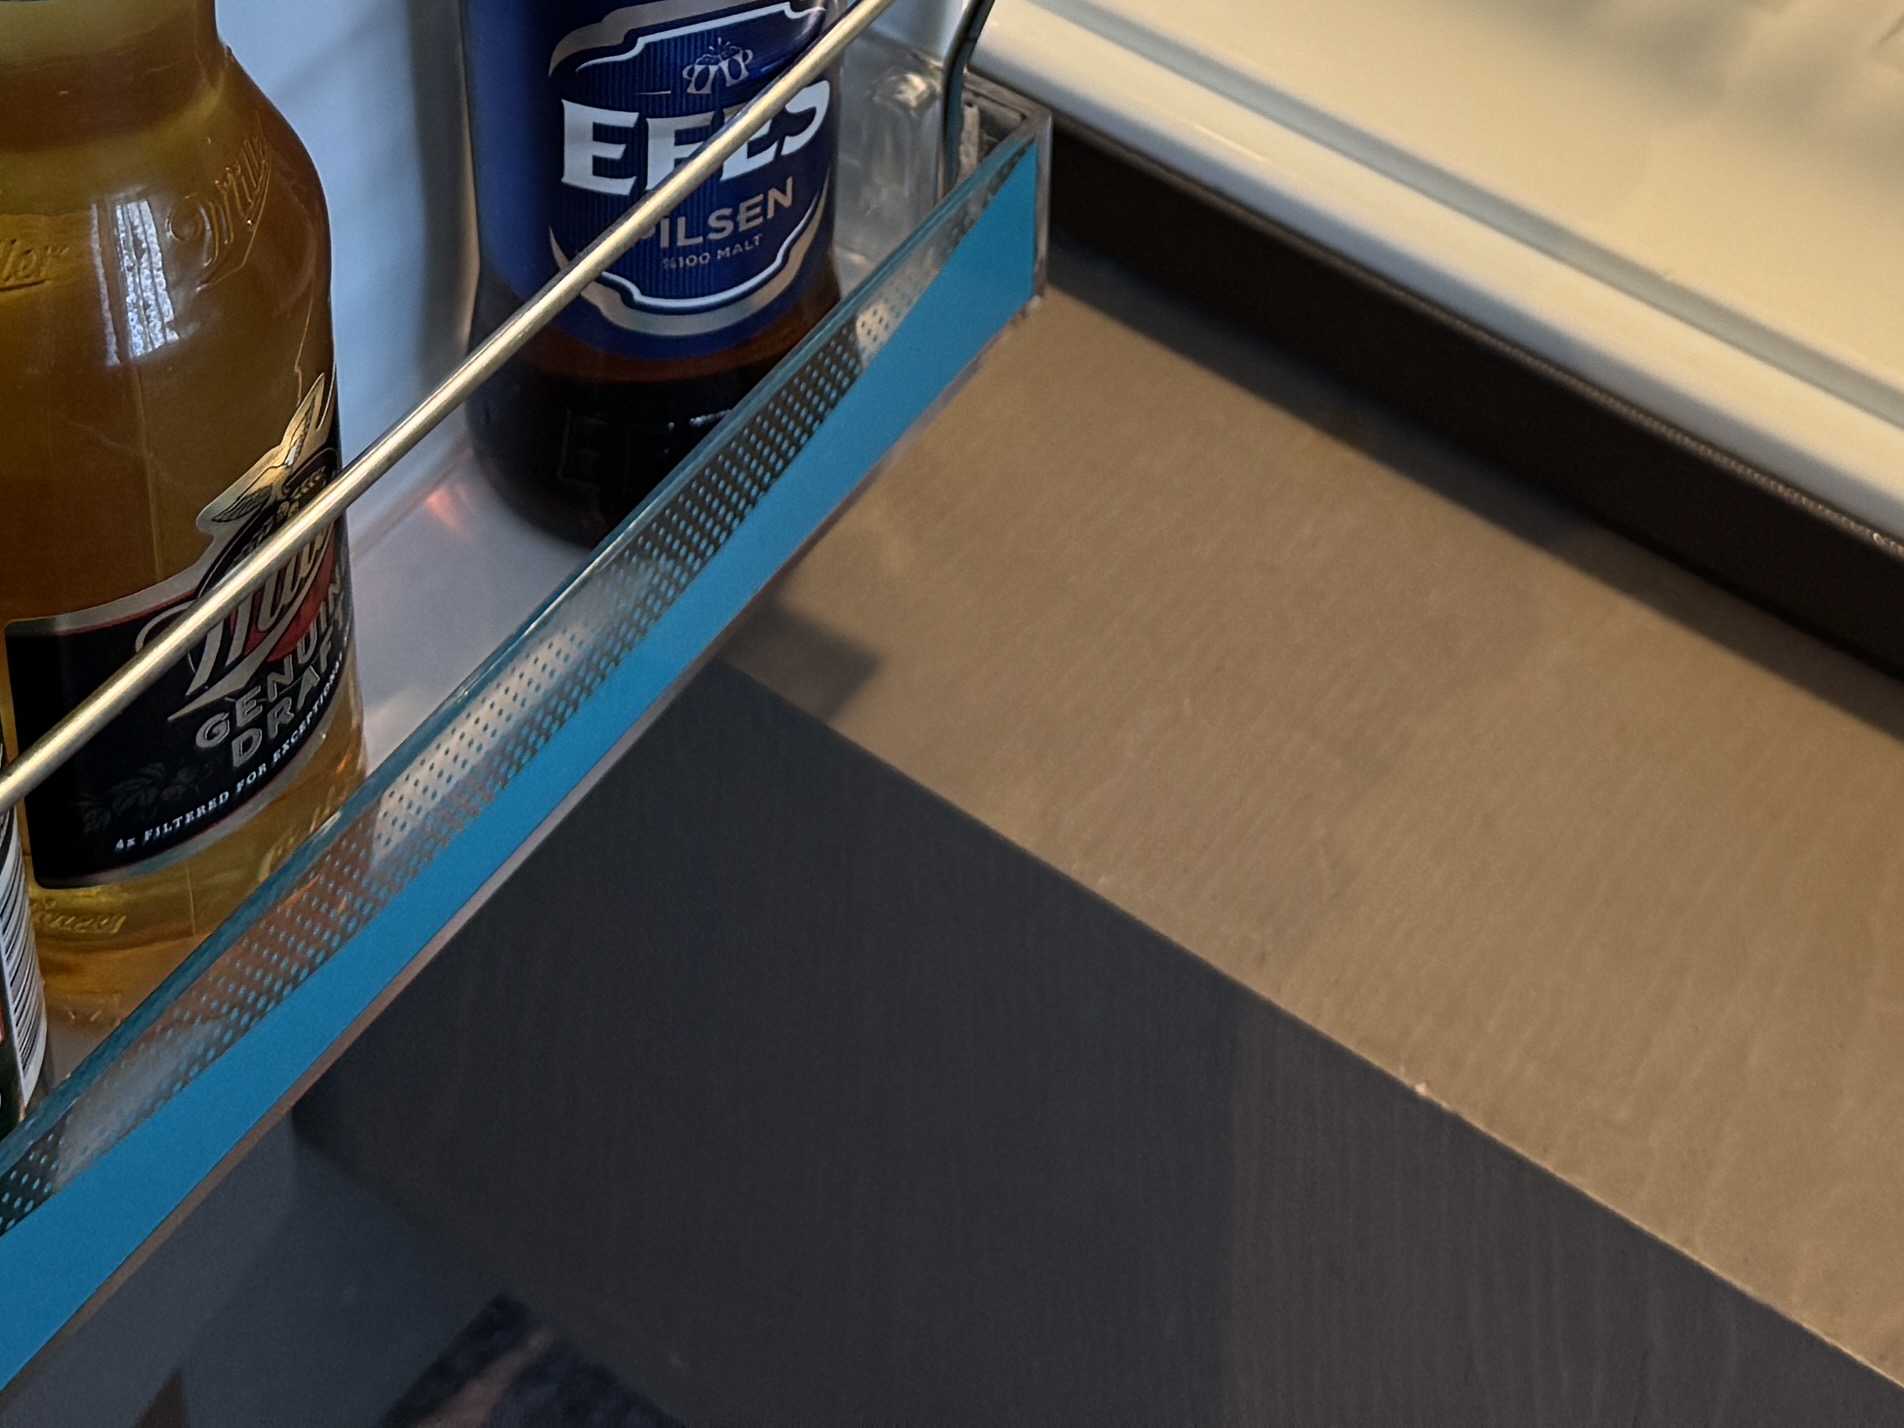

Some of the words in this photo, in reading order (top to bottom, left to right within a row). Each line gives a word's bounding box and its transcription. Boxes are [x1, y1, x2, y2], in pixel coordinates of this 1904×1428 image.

[644, 177, 795, 251] ILSEN
[716, 232, 764, 262] MALT
[143, 791, 230, 842] FILTERED
[236, 761, 268, 795] FOR
